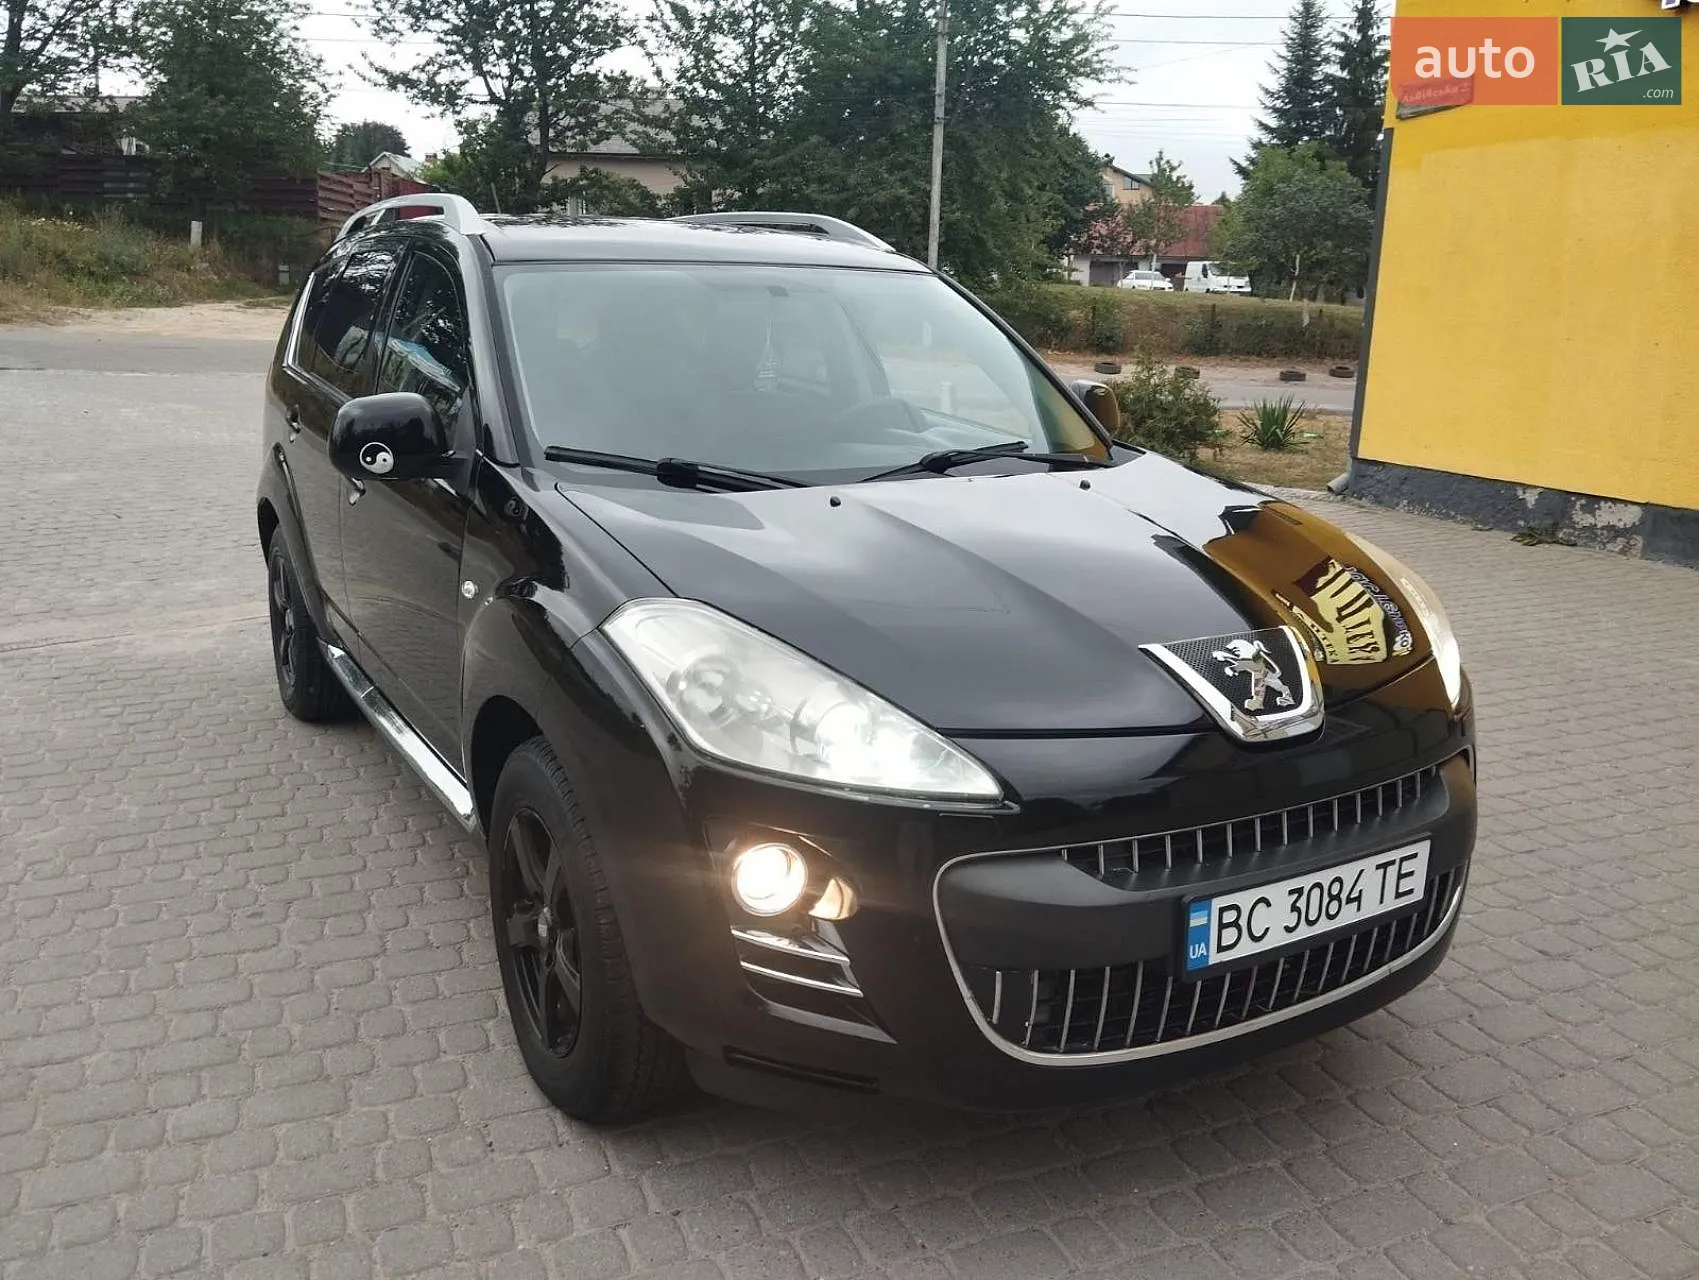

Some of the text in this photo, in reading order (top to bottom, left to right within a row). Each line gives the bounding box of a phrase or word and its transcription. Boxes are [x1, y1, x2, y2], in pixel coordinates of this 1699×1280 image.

[1216, 852, 1418, 954] BC 3084 TE
[1189, 942, 1208, 959] UA
